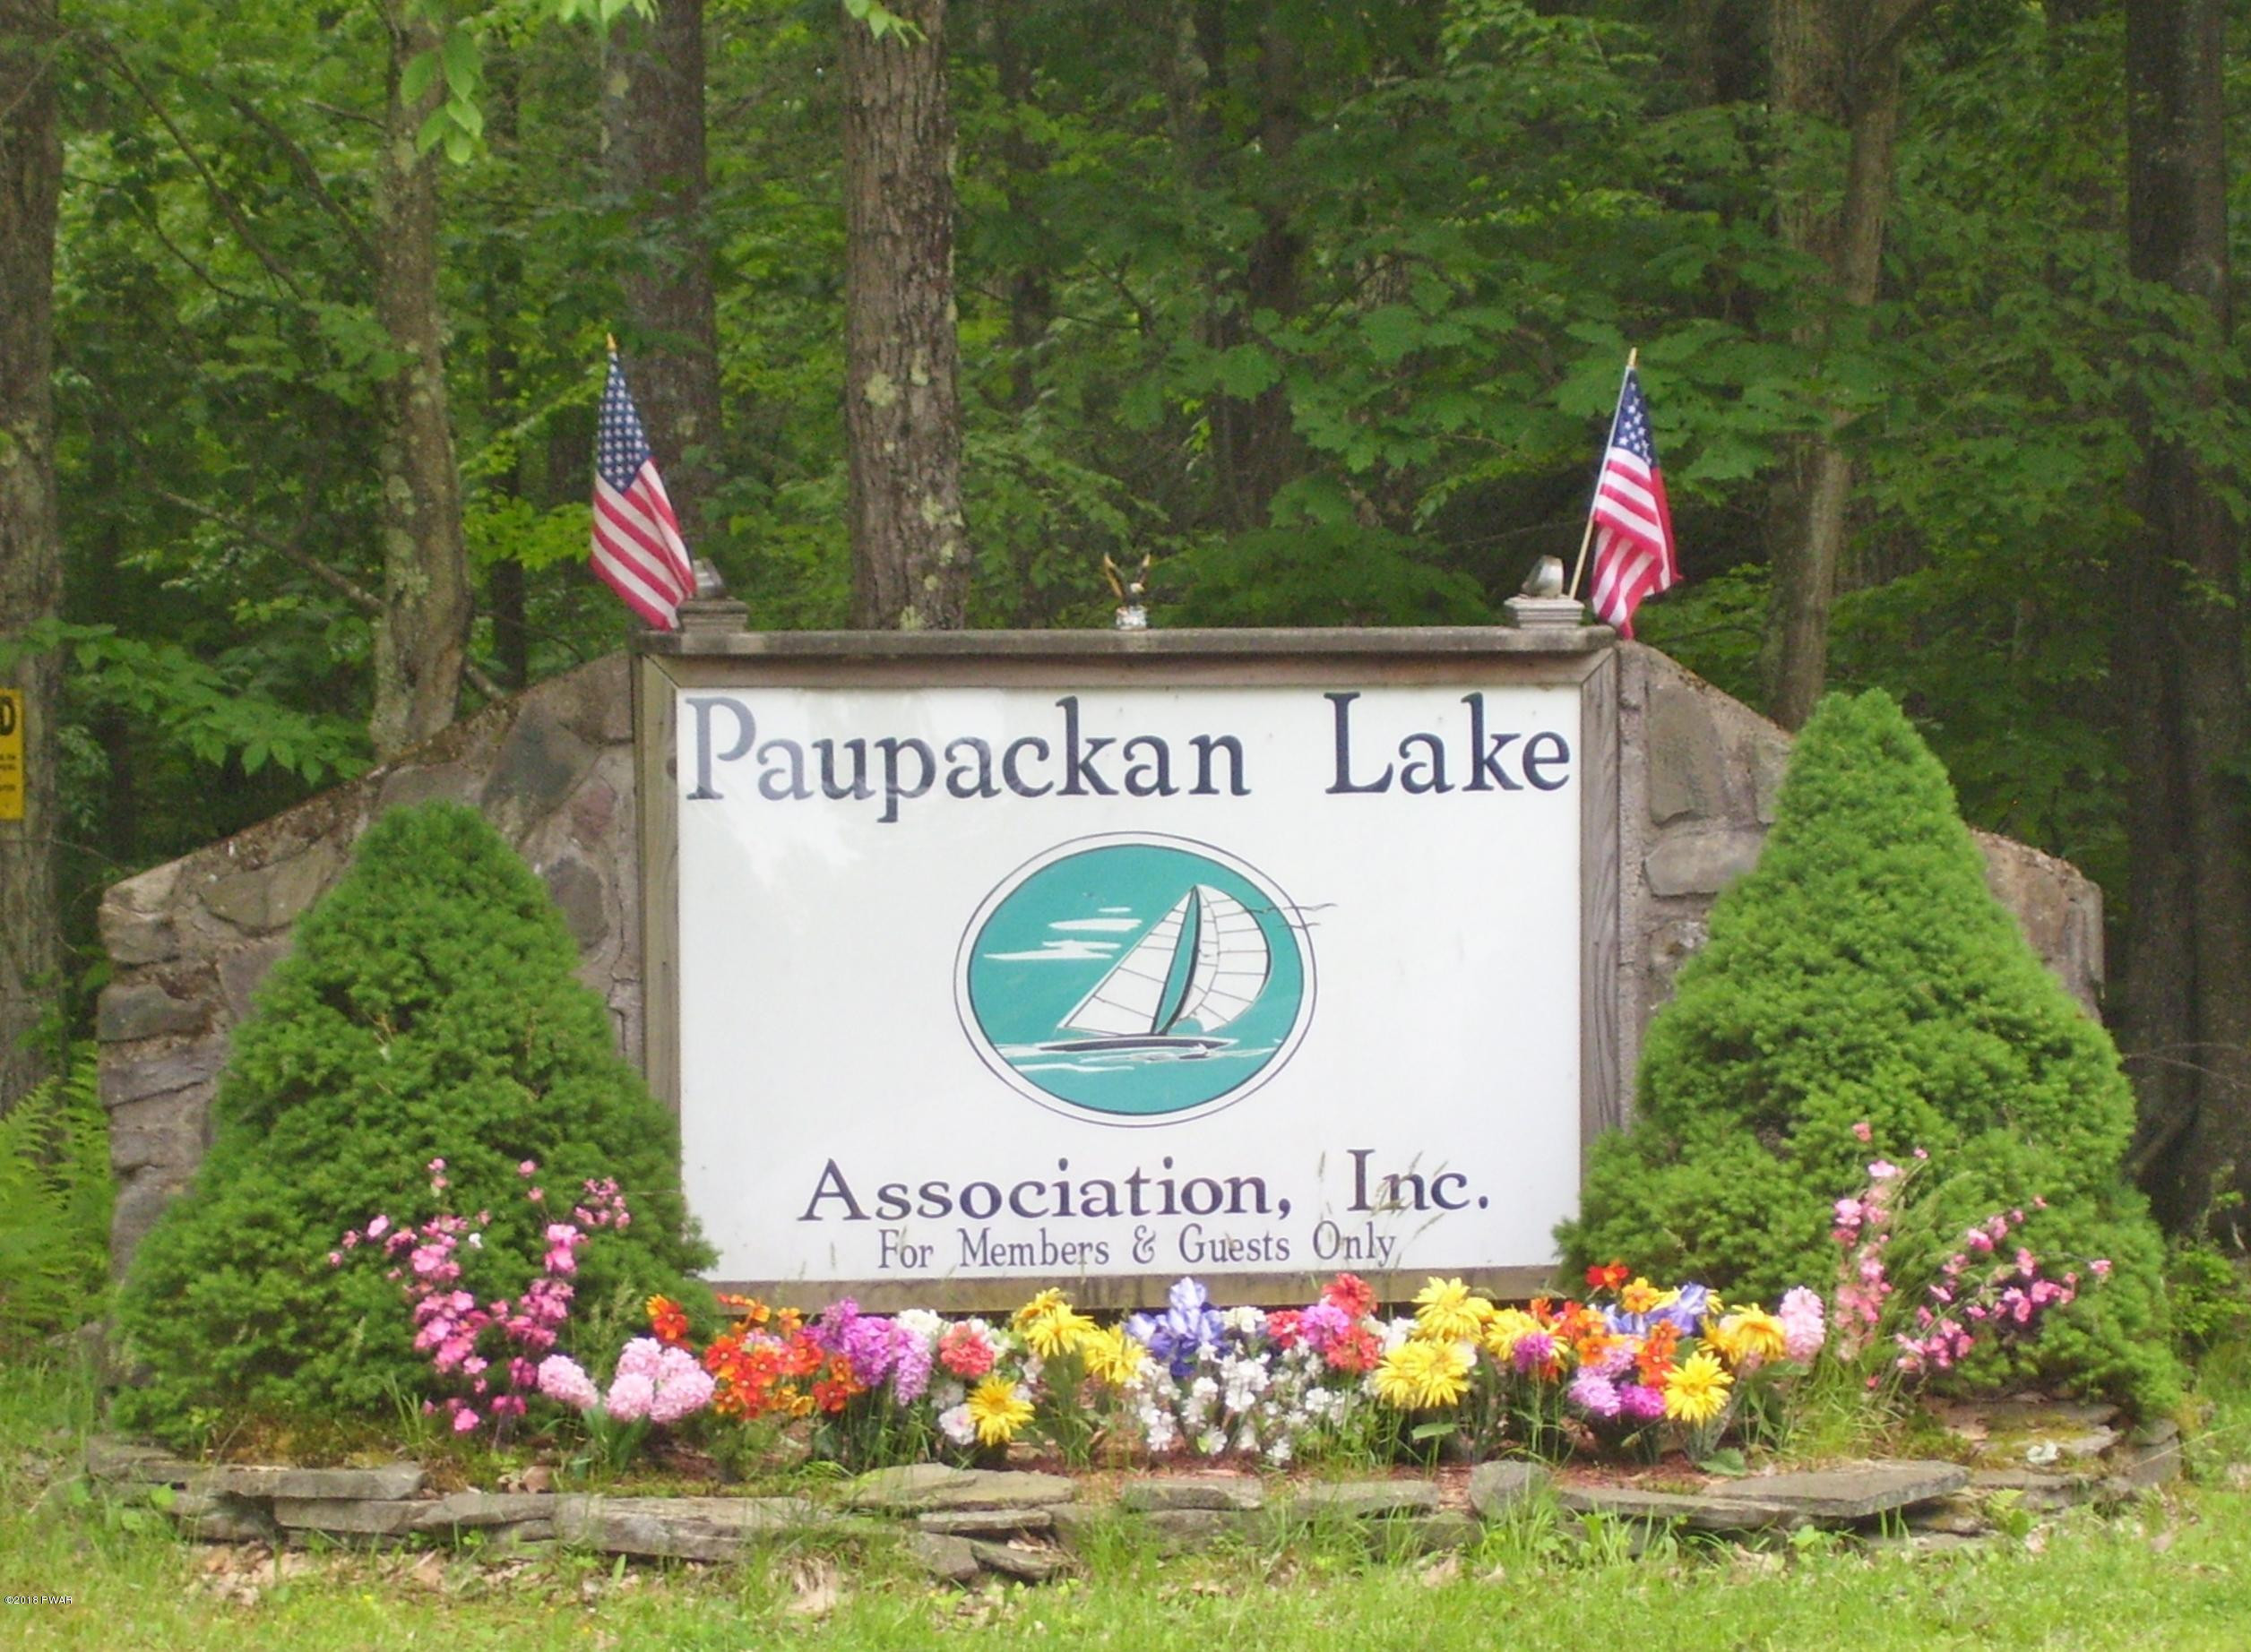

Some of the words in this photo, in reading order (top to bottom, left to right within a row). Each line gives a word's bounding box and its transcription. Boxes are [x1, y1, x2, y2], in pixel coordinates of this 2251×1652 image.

[686, 694, 1252, 823] Paupackan
[1324, 692, 1571, 794] Lake
[798, 1157, 1291, 1221] Association,
[1348, 1149, 1488, 1213] Inc.
[878, 1229, 934, 1269] For
[957, 1227, 1110, 1269] Members
[1132, 1225, 1156, 1265] &
[1178, 1223, 1290, 1264] Guests
[1313, 1220, 1397, 1264] Only
